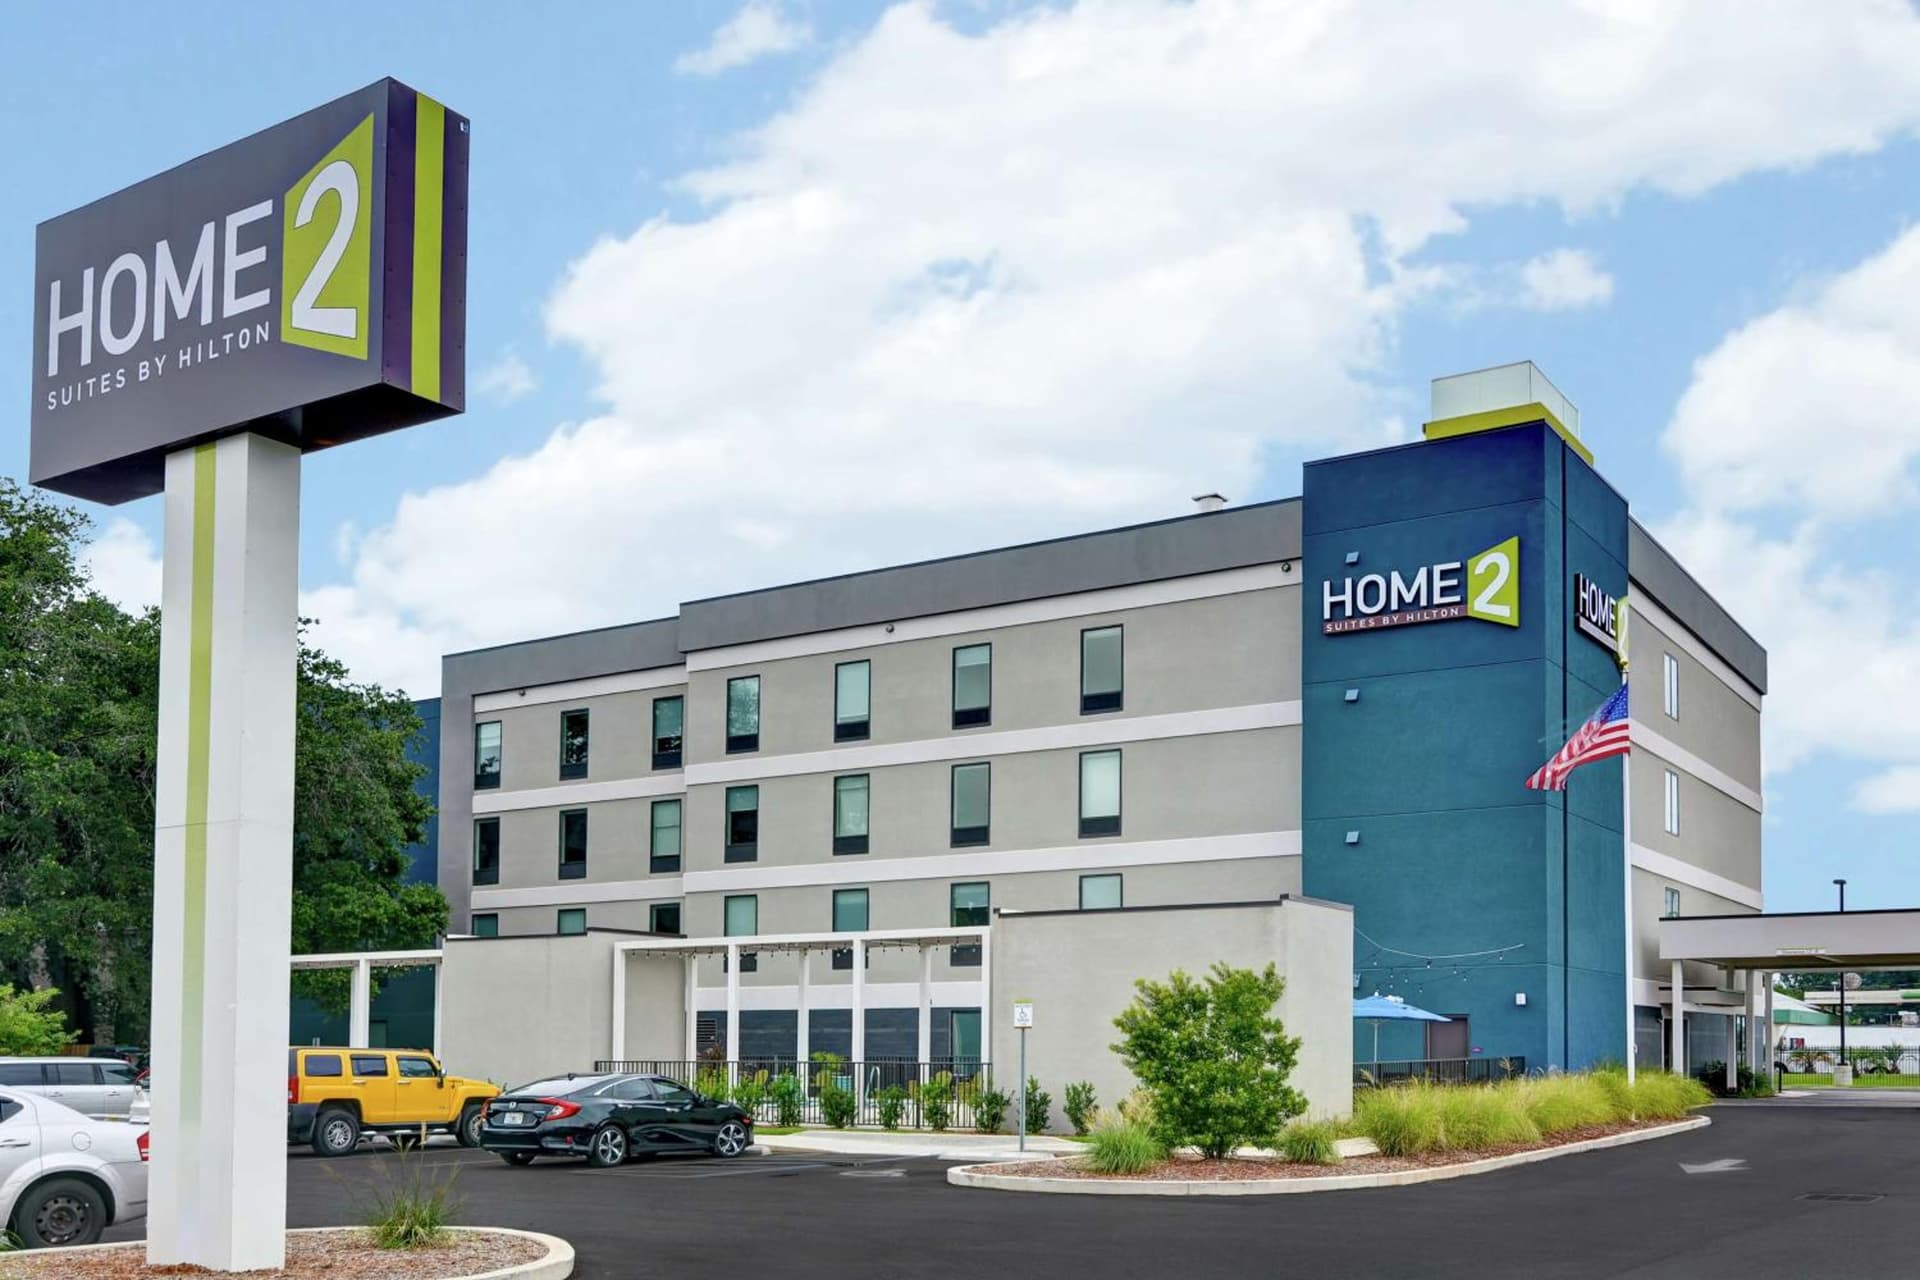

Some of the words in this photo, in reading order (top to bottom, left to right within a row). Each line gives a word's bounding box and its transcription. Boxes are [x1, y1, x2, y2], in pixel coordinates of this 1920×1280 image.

[47, 199, 273, 377] HOME
[291, 159, 360, 339] 2
[47, 368, 126, 410] SUITES
[138, 354, 167, 382] BY
[178, 321, 270, 368] HILTON
[1323, 561, 1461, 619] HOME
[1473, 551, 1510, 618] 2
[1579, 572, 1617, 637] HOME
[1325, 618, 1376, 632] SUITES
[1382, 615, 1399, 625] BY
[1406, 607, 1459, 621] HILTON
